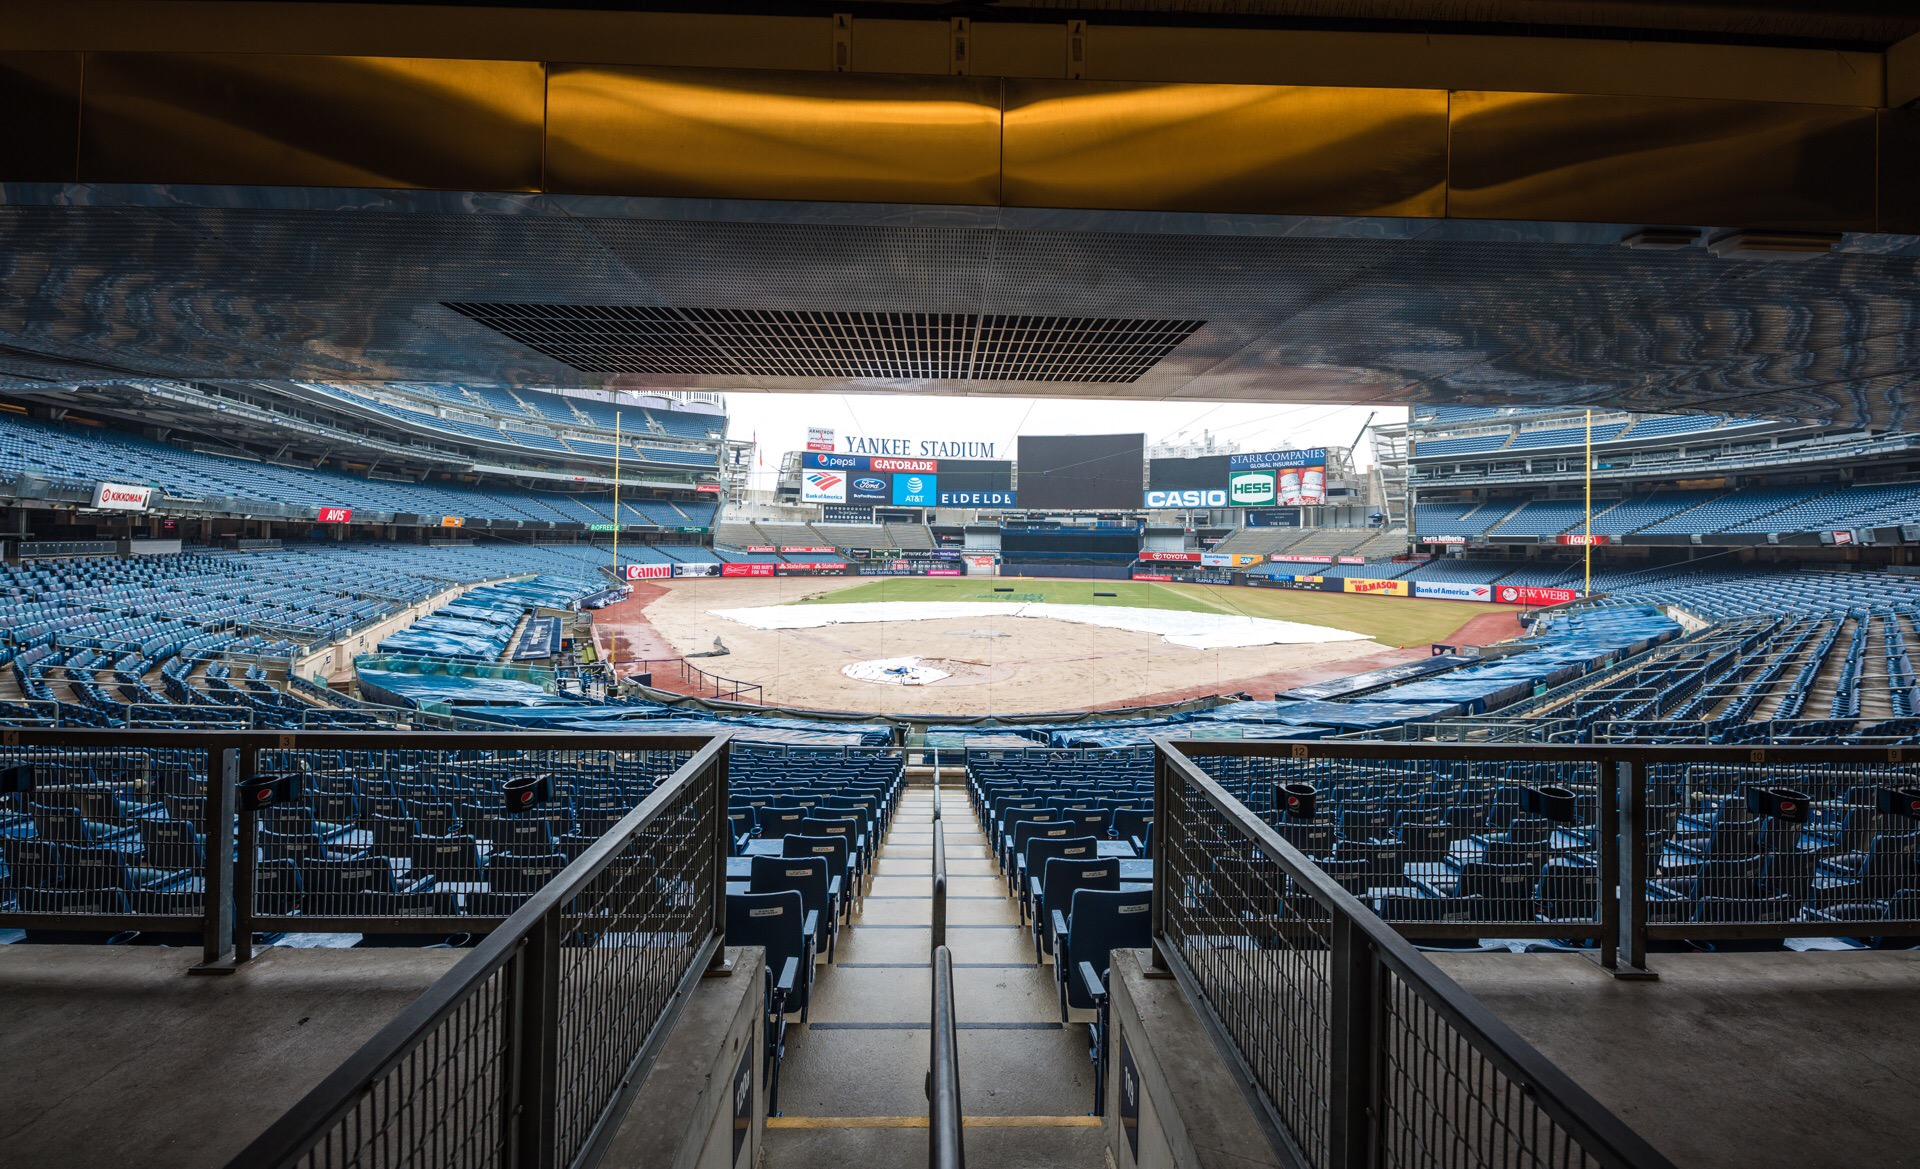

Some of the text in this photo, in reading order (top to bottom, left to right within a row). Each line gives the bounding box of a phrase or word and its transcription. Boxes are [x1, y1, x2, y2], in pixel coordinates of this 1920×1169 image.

[845, 436, 995, 458] YANKEE STADIUM
[1231, 449, 1325, 465] STARR COMPANIES
[830, 457, 856, 467] pepsi
[874, 459, 933, 471] GATORADE
[1273, 459, 1305, 467] INSURANCE
[859, 480, 879, 489] Ford
[1234, 482, 1272, 494] HESS
[111, 491, 143, 503] KIKKOMAN
[905, 495, 925, 503] AT&T
[1147, 490, 1226, 507] CASIO
[326, 510, 345, 520] AVIS
[1438, 534, 1466, 542] Authority
[1240, 557, 1253, 565] SAP
[627, 565, 671, 579] Canon
[1441, 588, 1469, 596] America
[1540, 589, 1570, 600] WEBB
[283, 737, 290, 746] 3
[1294, 747, 1305, 756] 12
[1891, 750, 1897, 759] 9
[1752, 752, 1763, 761] 10
